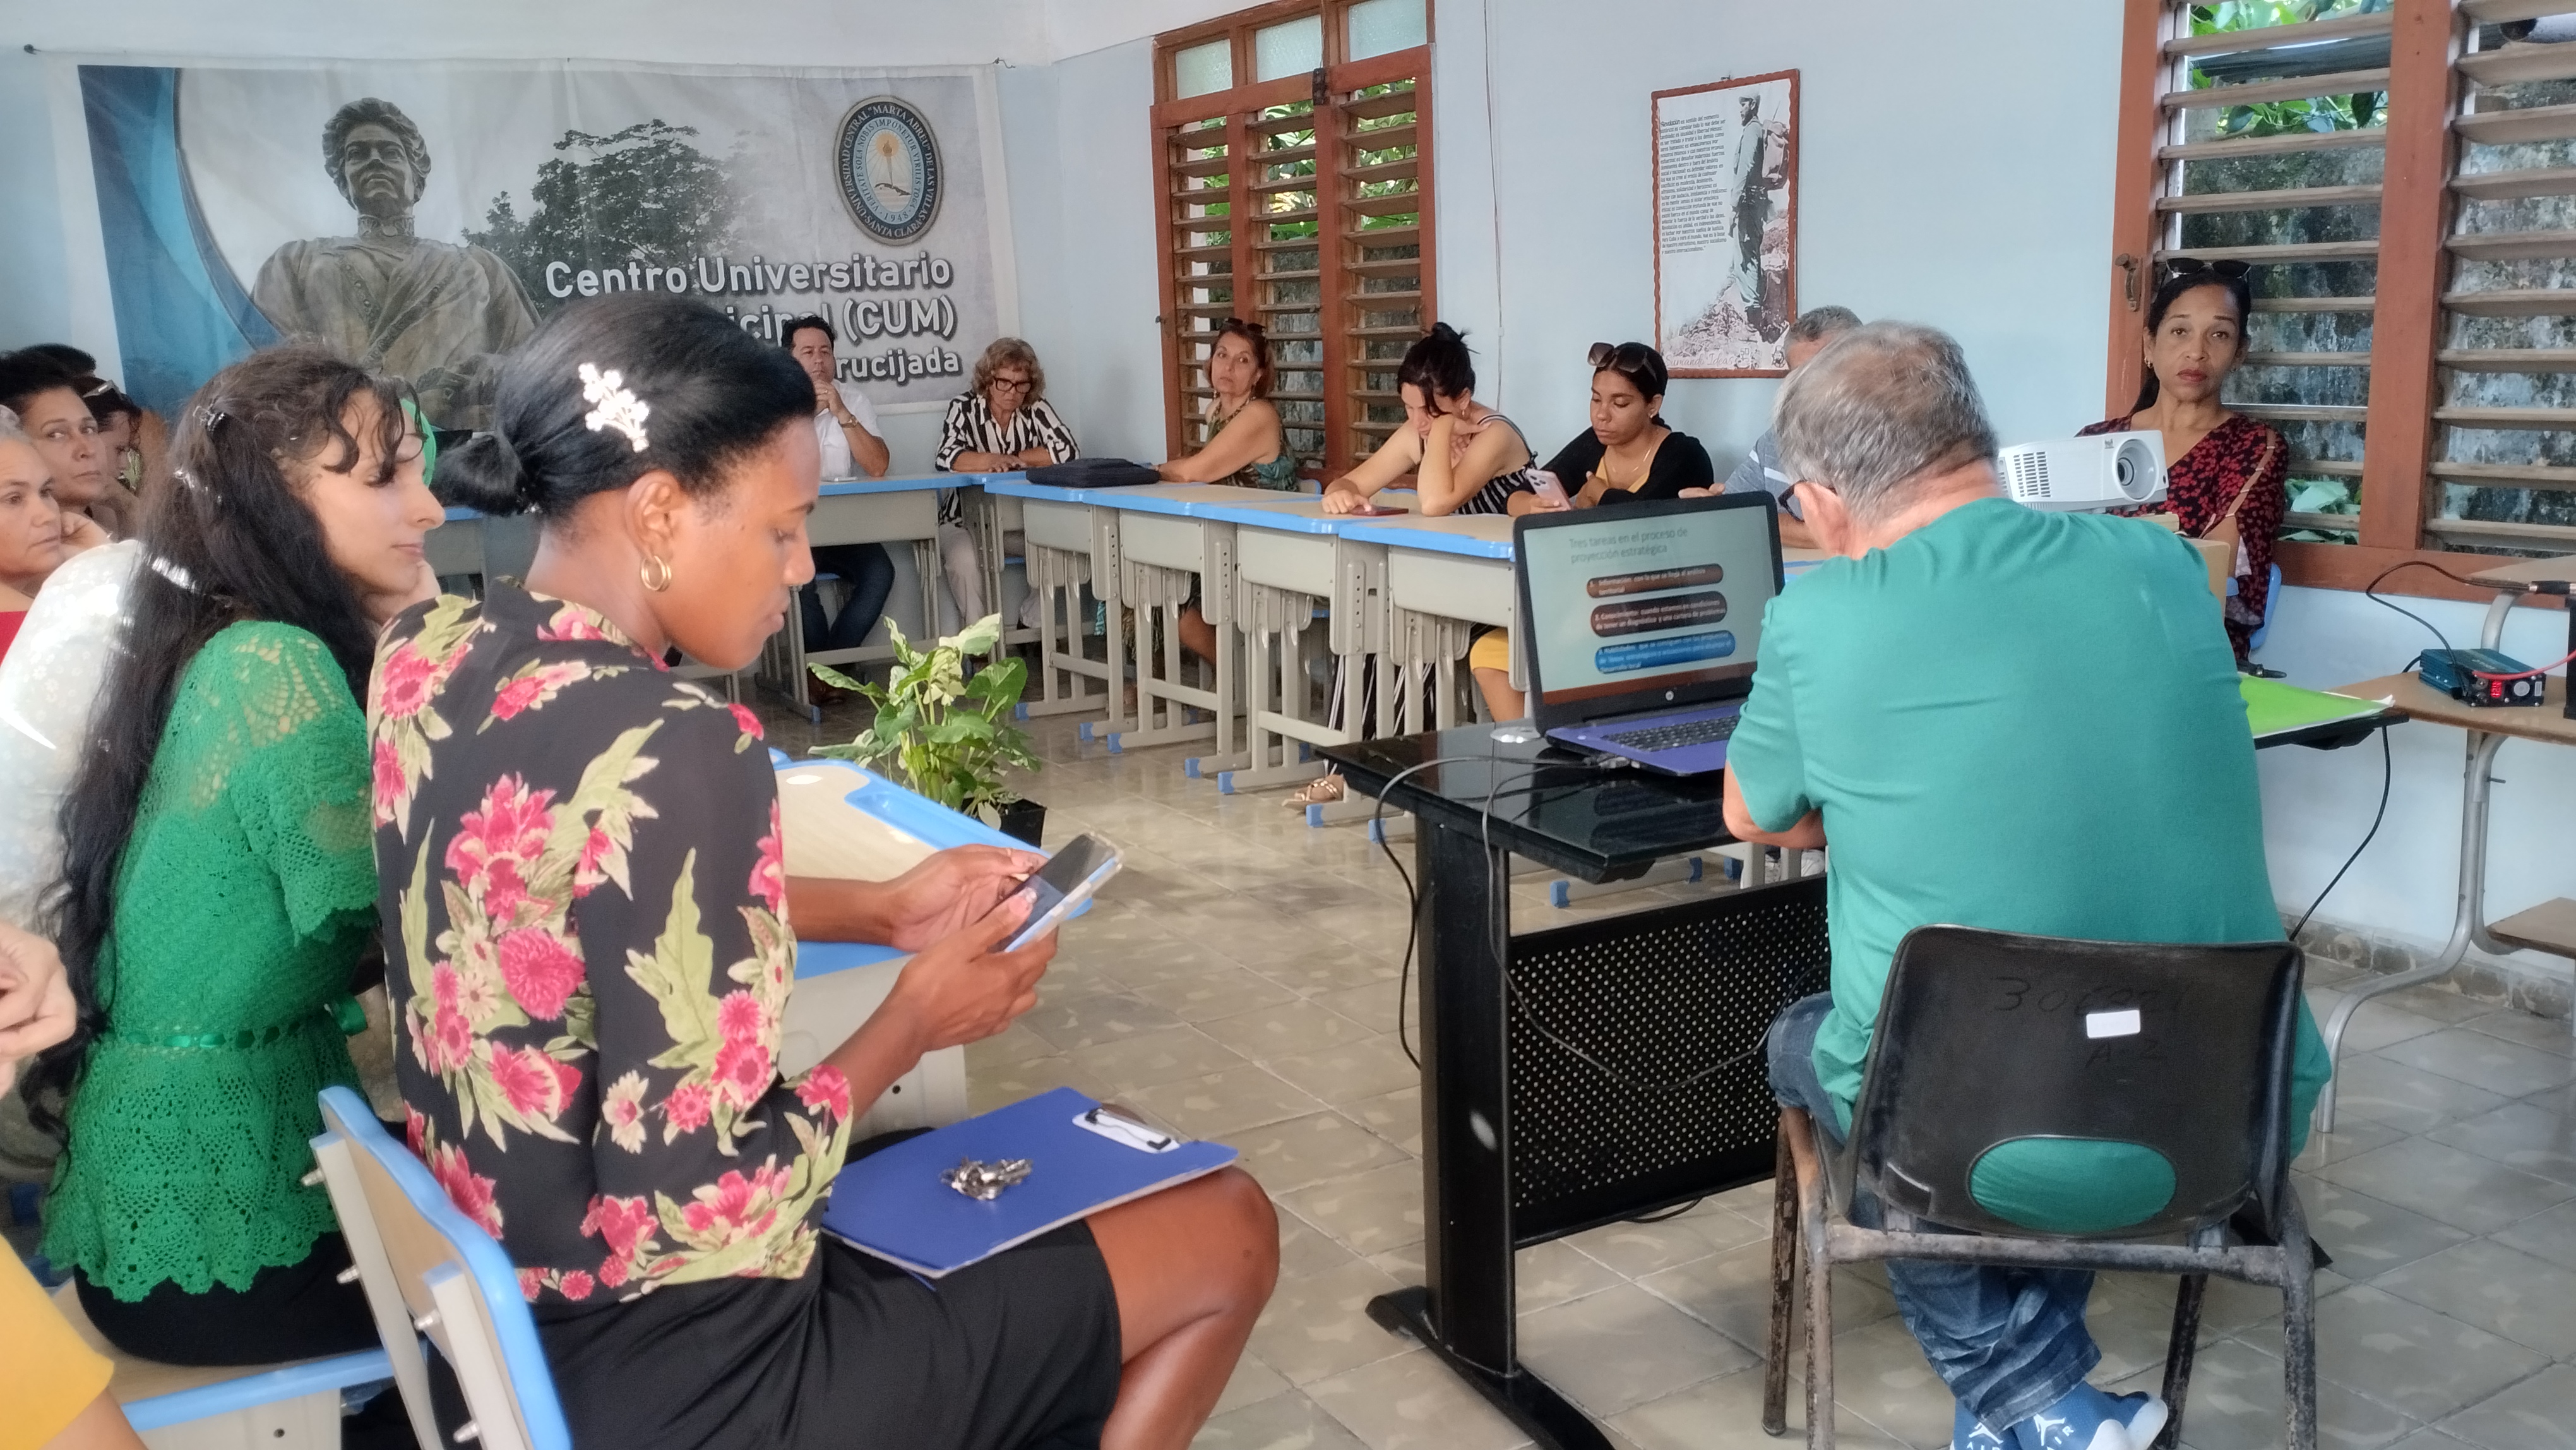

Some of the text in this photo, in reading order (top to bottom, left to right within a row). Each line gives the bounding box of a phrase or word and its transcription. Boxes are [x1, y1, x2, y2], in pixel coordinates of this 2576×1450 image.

[845, 111, 869, 148] CENTRAL
[925, 152, 933, 165] DE
[857, 124, 874, 146] NOBIS
[866, 216, 921, 237] SANTA CLARA
[884, 212, 909, 222] 1948
[546, 251, 950, 298] Centro Universitario
[843, 295, 954, 342] (CUM)
[836, 347, 960, 383] rucijada
[1570, 527, 1687, 548] Tres tareas en el proceso de
